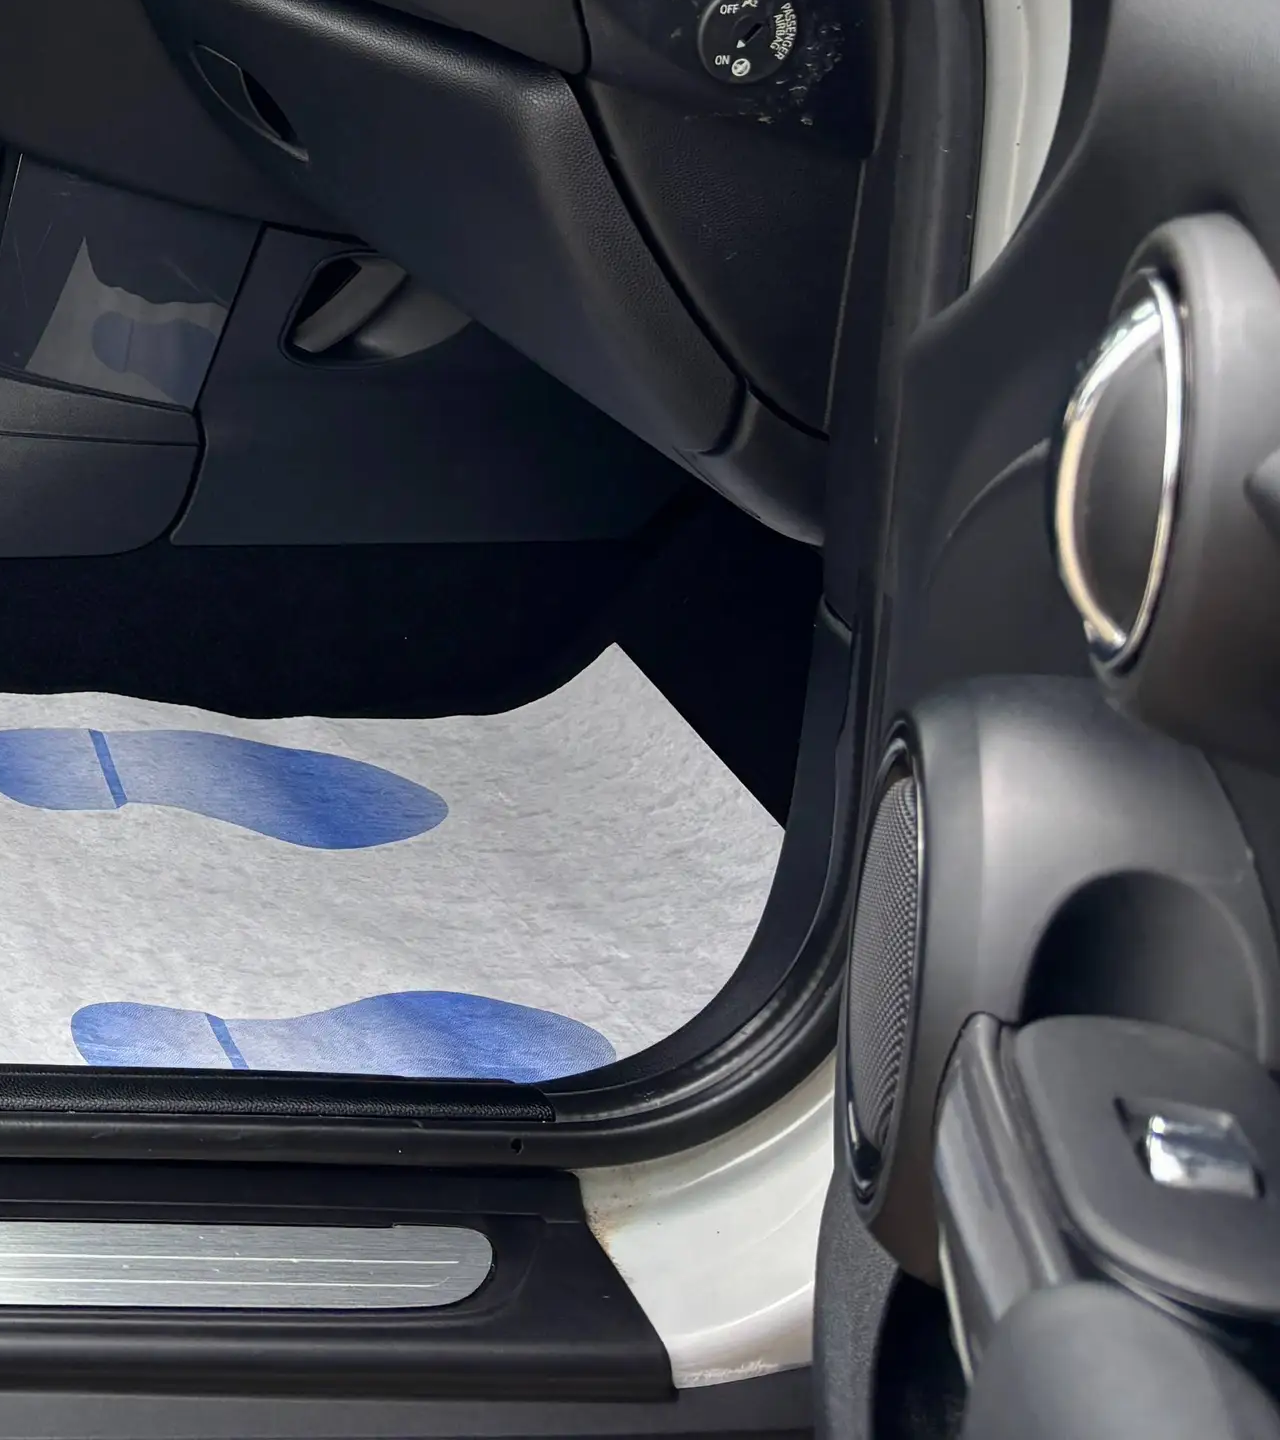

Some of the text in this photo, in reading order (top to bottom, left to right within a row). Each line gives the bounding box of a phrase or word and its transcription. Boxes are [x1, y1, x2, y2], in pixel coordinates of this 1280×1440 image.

[720, 3, 740, 15] OFF
[770, 13, 786, 51] AIRBAG
[775, 2, 797, 60] PASSENGER
[714, 54, 731, 65] ON
